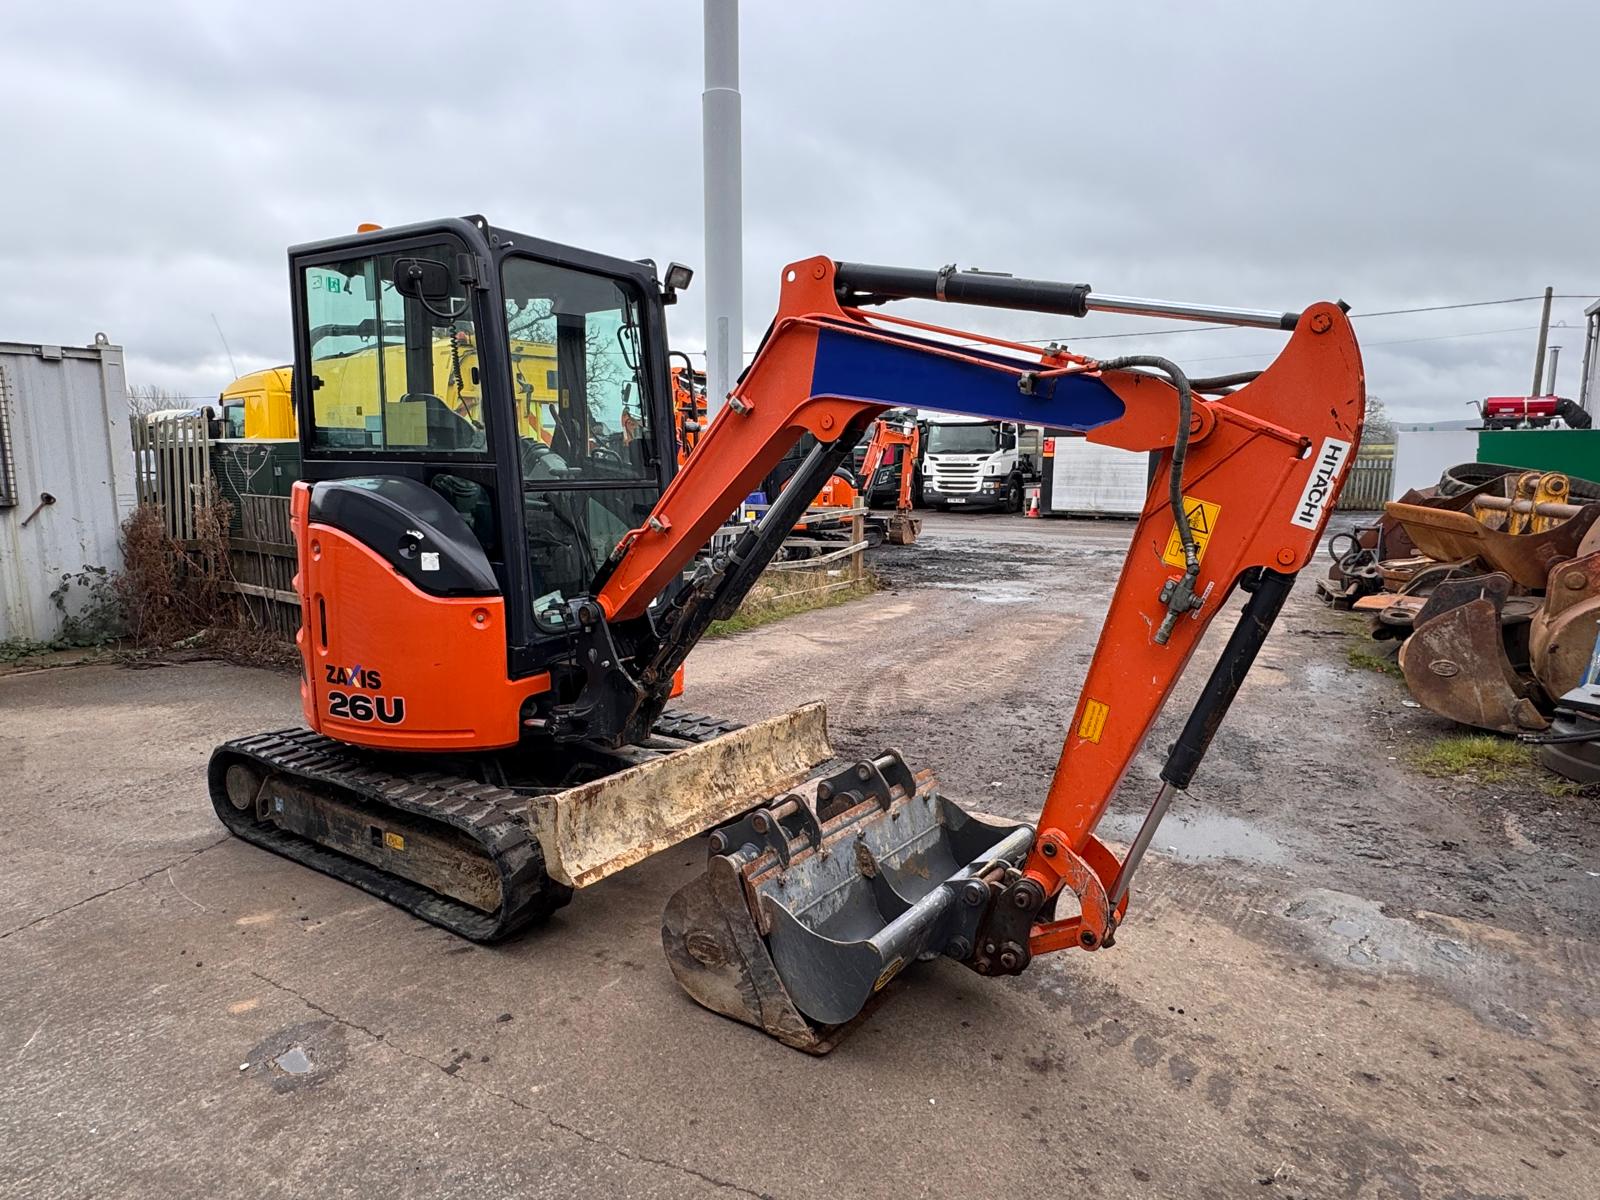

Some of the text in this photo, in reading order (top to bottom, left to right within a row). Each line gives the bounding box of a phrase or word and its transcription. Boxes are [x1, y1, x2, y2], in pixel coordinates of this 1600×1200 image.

[1299, 444, 1342, 523] HITACHI
[325, 664, 381, 690] ZAXIS
[328, 690, 405, 725] 26U
